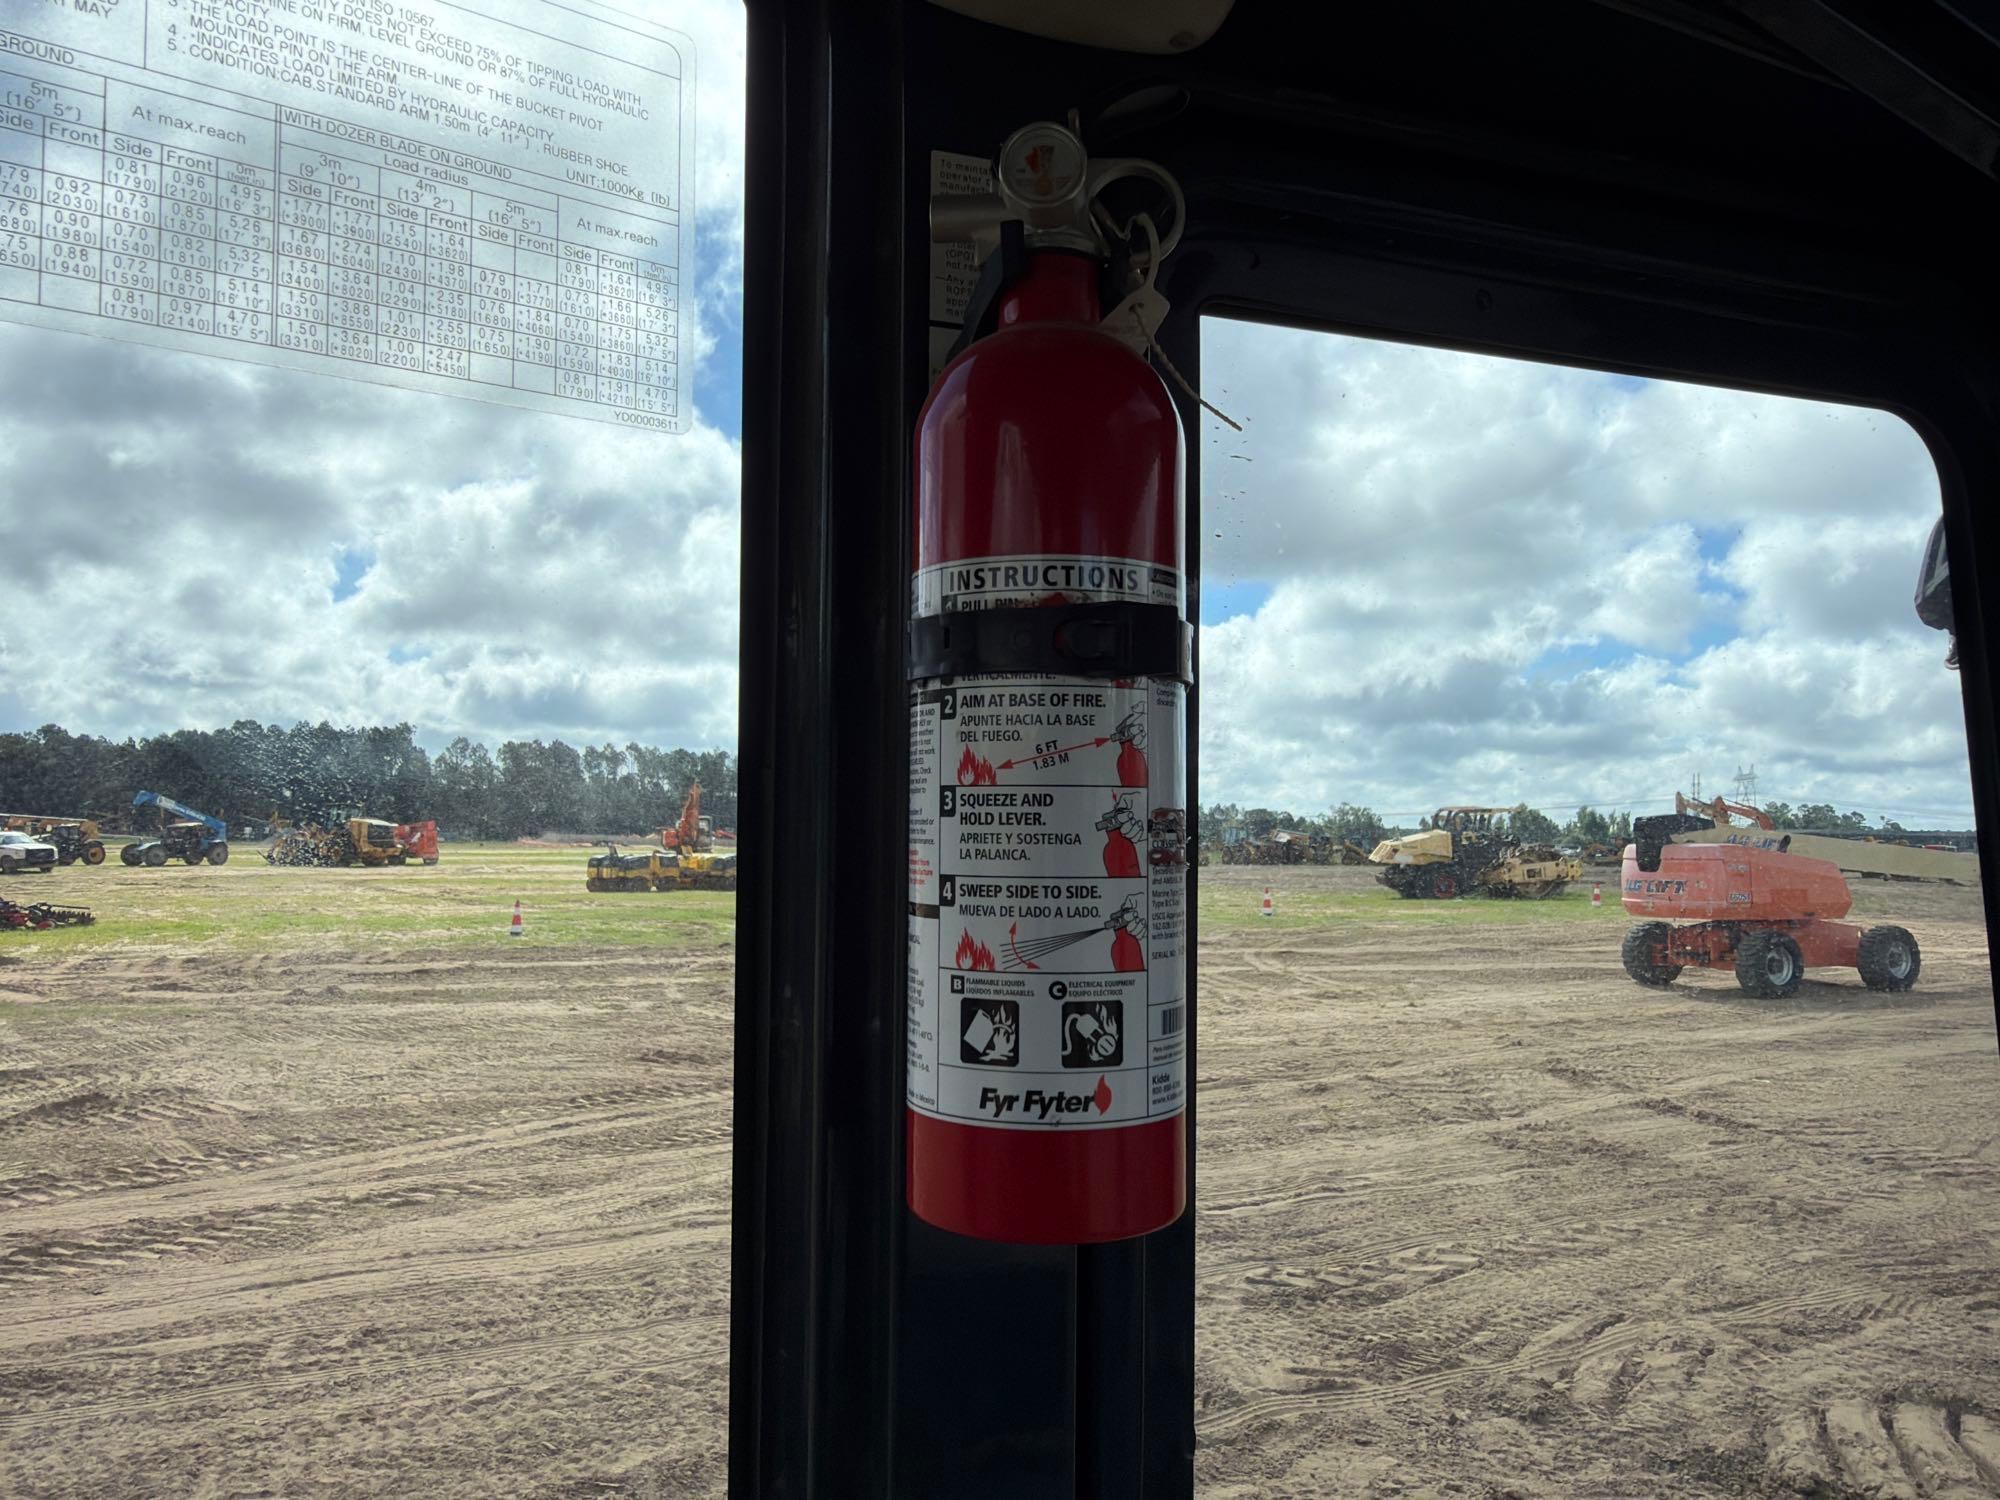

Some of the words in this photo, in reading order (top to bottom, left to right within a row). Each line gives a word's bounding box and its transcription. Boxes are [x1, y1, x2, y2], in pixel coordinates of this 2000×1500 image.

[74, 0, 113, 18] MAY
[190, 15, 274, 49] MOUNTING
[279, 41, 303, 58] PIN
[308, 49, 330, 66] ON
[335, 57, 362, 75] THE
[301, 5, 323, 22] ON
[370, 26, 411, 48] LEVEL
[415, 40, 474, 67] GROUND
[478, 59, 496, 74] OR
[500, 66, 525, 84] 87%
[529, 75, 546, 88] OF
[550, 81, 578, 100] FULL
[582, 93, 649, 120] HYDRAULIC
[344, 4, 383, 26] DOES
[387, 17, 415, 36] NOT
[420, 28, 472, 53] EXCEED
[476, 45, 501, 63] 75%
[505, 54, 522, 67] OF
[526, 61, 574, 85] TIPPING
[578, 77, 609, 96] LOAD
[613, 89, 641, 106] WITH
[192, 1, 221, 19] THE
[226, 11, 269, 32] LOAD
[274, 25, 318, 46] POINT
[322, 39, 336, 53] IS
[341, 44, 367, 63] THE
[372, 54, 462, 91] CENTER-LINE
[466, 82, 484, 96] OF
[489, 87, 513, 105] THE
[516, 97, 566, 121] BUCKET
[569, 112, 604, 131] PIVOT
[30, 82, 58, 100] 5m
[284, 56, 324, 78] LOAD
[329, 69, 384, 94] LIMITED
[388, 86, 406, 101] BY
[411, 92, 487, 124] HYDRAULIC
[132, 106, 153, 121] At
[50, 122, 99, 146] Front
[400, 104, 429, 121] ARM
[434, 113, 470, 132] 1.50m
[544, 144, 592, 165] RUBBER
[114, 138, 153, 158] Side
[285, 110, 320, 130] WITH
[326, 120, 376, 144] DOZER
[381, 135, 426, 158] BLADE
[430, 149, 450, 164] ON
[455, 156, 512, 179] GROUND
[166, 150, 212, 172] Front
[384, 154, 419, 173] Load
[424, 166, 469, 186] radius
[289, 180, 322, 198] Side
[416, 180, 437, 194] 4m
[334, 191, 375, 210] Front
[387, 203, 419, 220] Side
[577, 218, 591, 231] At
[564, 245, 592, 260] Side
[601, 254, 634, 272] Front
[950, 565, 1138, 591] INSTRUCTIONS
[944, 695, 953, 715] 2
[960, 694, 985, 708] AIM
[988, 693, 1005, 707] AT
[1009, 693, 1046, 707] BASE
[1050, 693, 1069, 707] OF
[1073, 694, 1106, 708] FIRE.
[960, 714, 1002, 726] APUNTE
[1006, 714, 1043, 726] HACIA
[1047, 714, 1061, 726] LA
[1066, 714, 1096, 726] BASE
[960, 730, 979, 743] DEL
[982, 730, 1022, 742] FUEGO.
[1035, 744, 1043, 755] 6
[1044, 740, 1059, 753] FT
[1032, 756, 1056, 771] 1.83
[1059, 752, 1070, 764] M
[943, 790, 952, 810] 3
[960, 793, 1017, 809] SQUEEZE
[1021, 793, 1054, 807] AND
[960, 812, 994, 826] HOLD
[999, 812, 1046, 826] LEVER.
[960, 832, 1003, 845] APRIETE
[1005, 832, 1013, 844] Y
[1016, 832, 1081, 845] SOSTENGA
[960, 848, 972, 860] LA
[975, 848, 1030, 861] PALANCA.
[943, 882, 952, 900] 4
[960, 884, 1002, 898] SWEEP
[1006, 885, 1039, 899] SIDE
[1042, 885, 1062, 899] TO
[1066, 885, 1101, 899] SIDE.
[960, 905, 996, 917] MUEVA
[1000, 905, 1015, 917] DE
[1019, 906, 1051, 918] LADO
[1054, 906, 1064, 918] A
[1067, 906, 1101, 918] LADO.
[979, 1087, 1019, 1118] Fyr
[1023, 1090, 1095, 1120] Fyter
